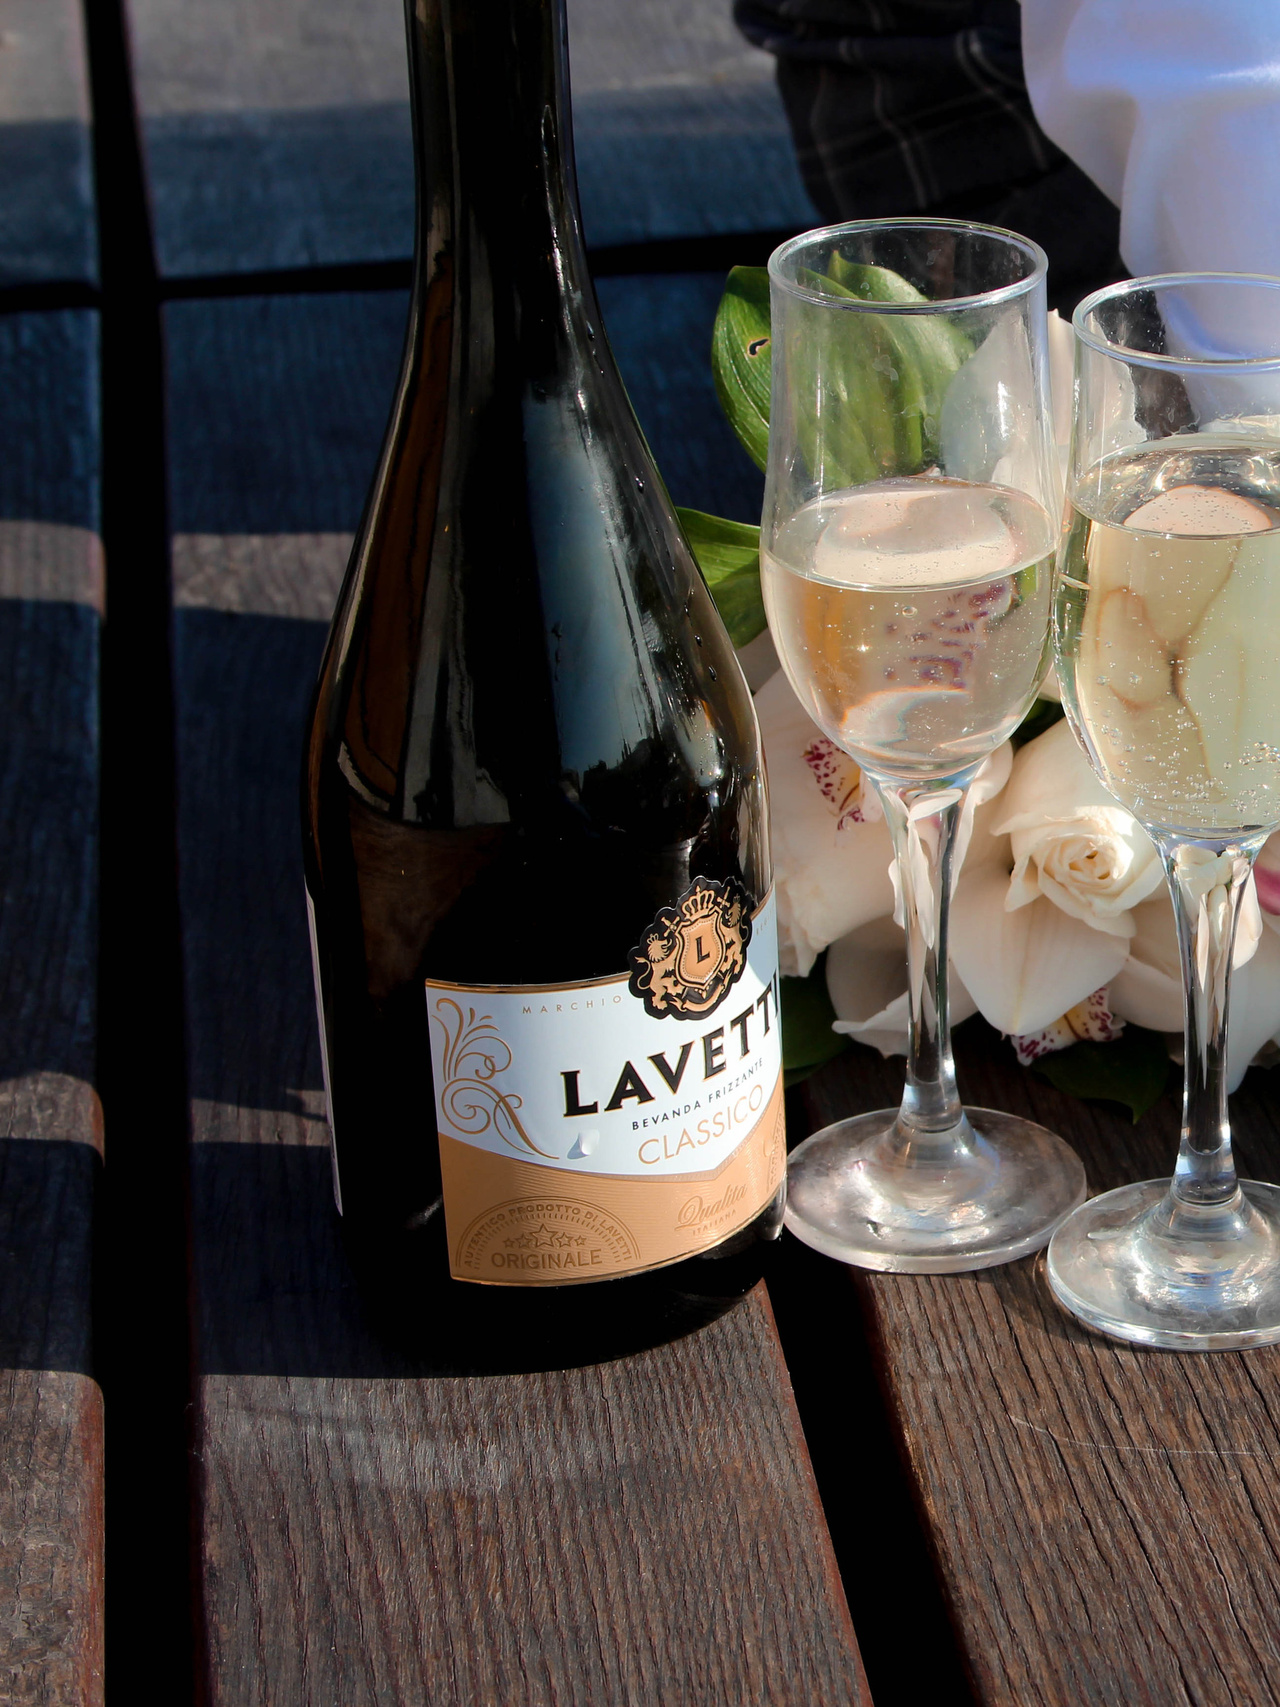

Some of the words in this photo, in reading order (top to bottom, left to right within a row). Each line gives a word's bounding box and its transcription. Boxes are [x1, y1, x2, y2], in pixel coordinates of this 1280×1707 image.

[696, 936, 710, 964] L
[522, 994, 623, 1015] MARCHIO
[632, 1100, 701, 1131] BEVANDA
[708, 1058, 764, 1103] FRIZZANTE
[638, 1084, 764, 1165] CLASSICO
[464, 1213, 505, 1268] AUTENTICO
[508, 1203, 581, 1217] PRODOTTO
[584, 1210, 598, 1222] DI
[600, 1219, 632, 1261] LAVETTI
[692, 1209, 736, 1236] ITALIANA
[491, 1249, 603, 1270] ORIGINALE
